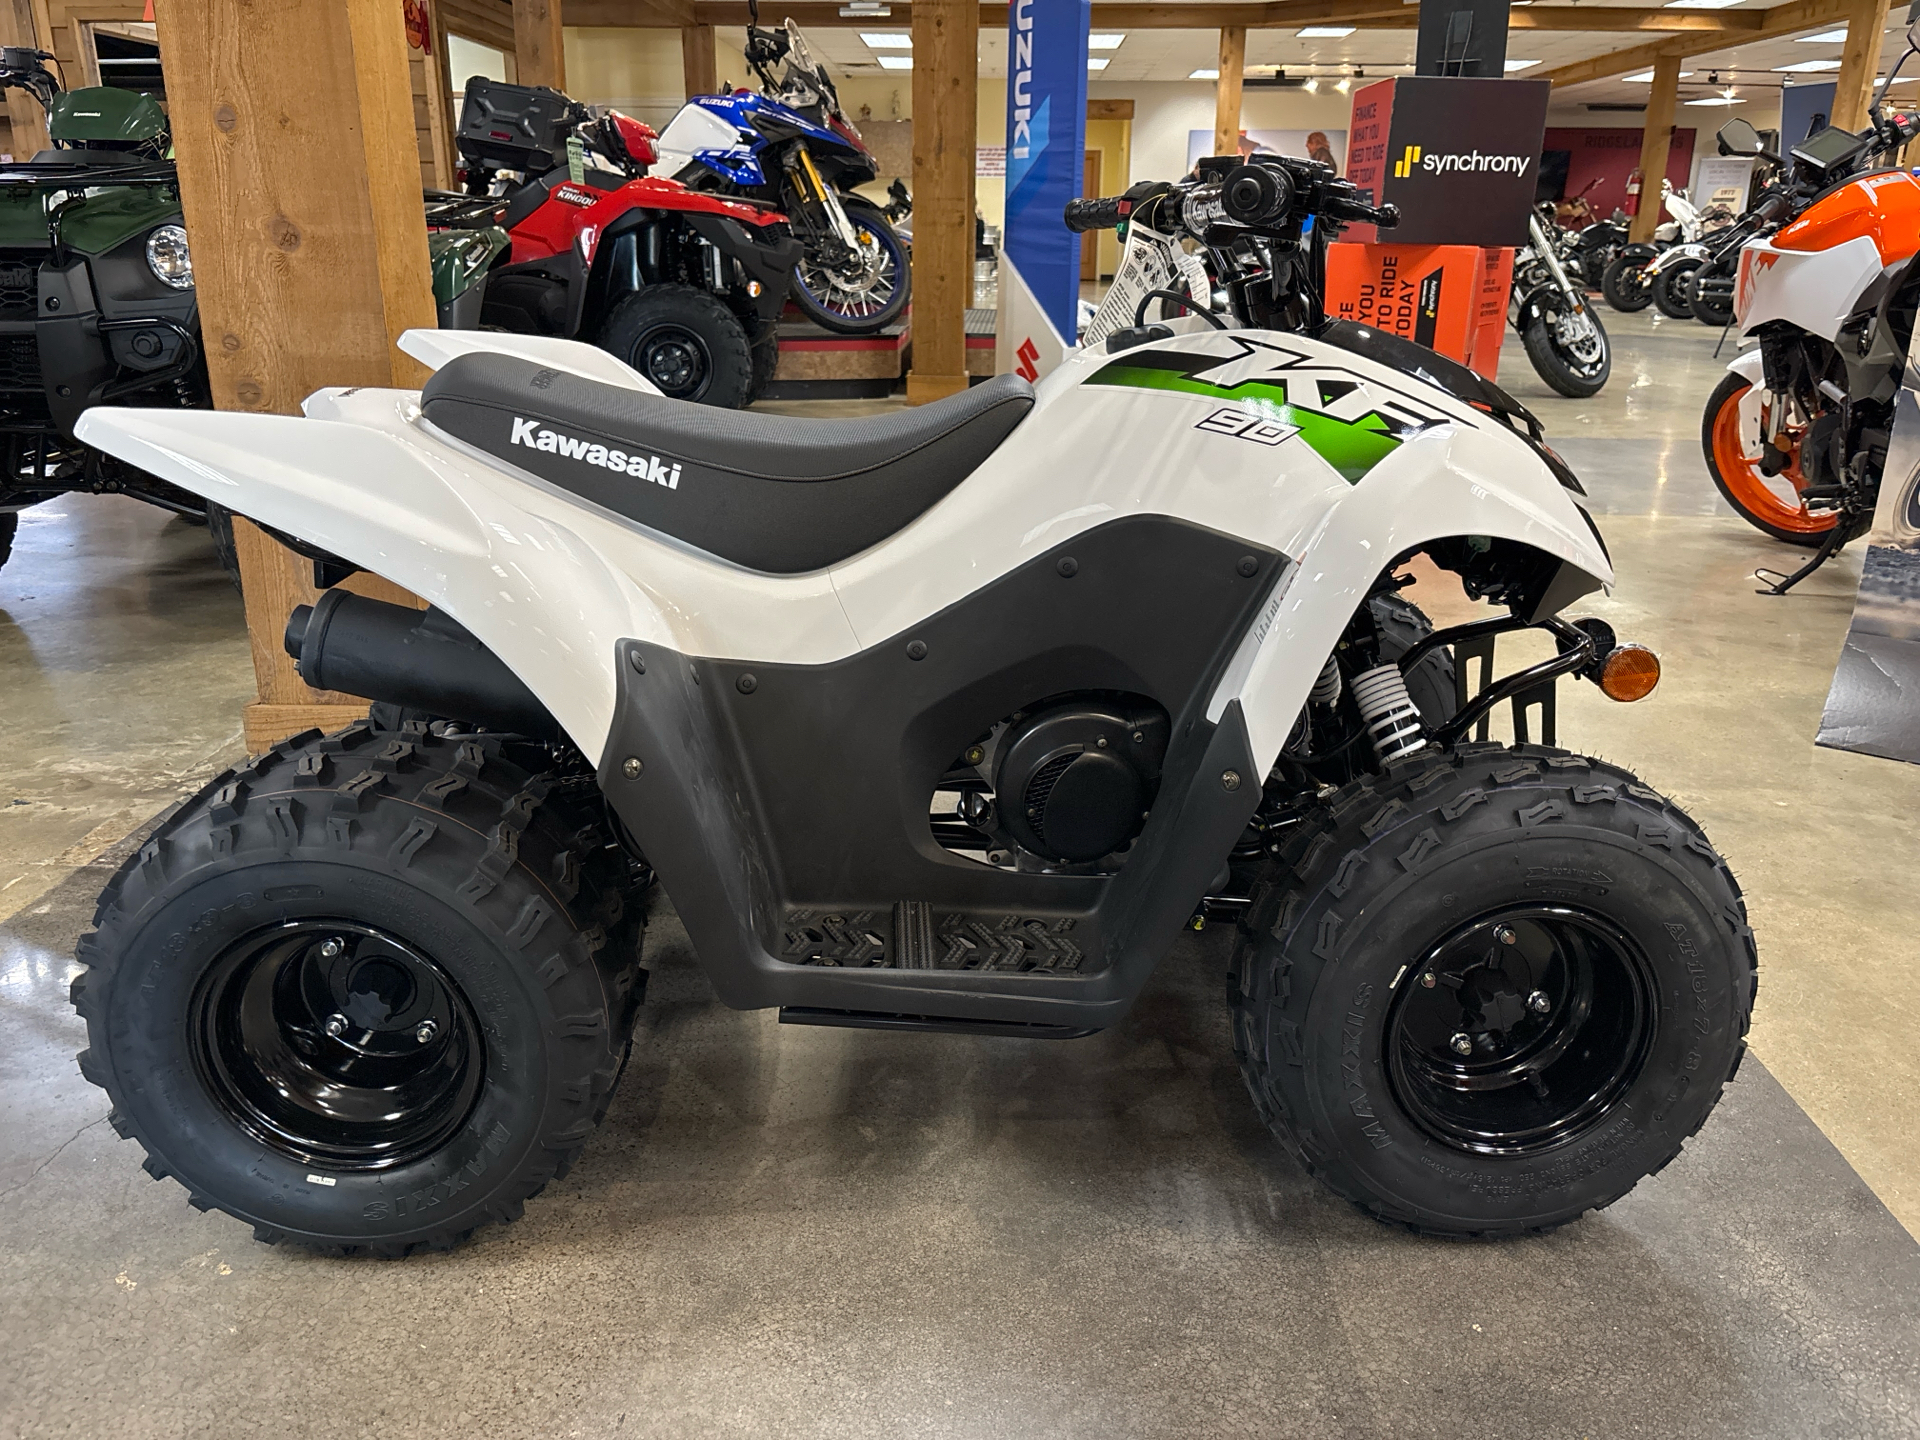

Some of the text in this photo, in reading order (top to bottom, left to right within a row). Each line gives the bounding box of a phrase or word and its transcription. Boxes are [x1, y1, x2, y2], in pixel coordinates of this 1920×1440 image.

[699, 97, 735, 109] SUZUKI
[1354, 102, 1378, 122] FINANCE
[1423, 150, 1531, 178] synchrony
[1358, 284, 1375, 321] YOU
[1376, 256, 1398, 328] TO RIDE
[1395, 280, 1415, 338] TODAY
[1194, 408, 1305, 447] 90
[510, 416, 682, 490] Kawasaki
[1552, 867, 1591, 878] ROTATION
[1341, 981, 1394, 1150] MAXXIS
[363, 1120, 512, 1222] MAXXIS
